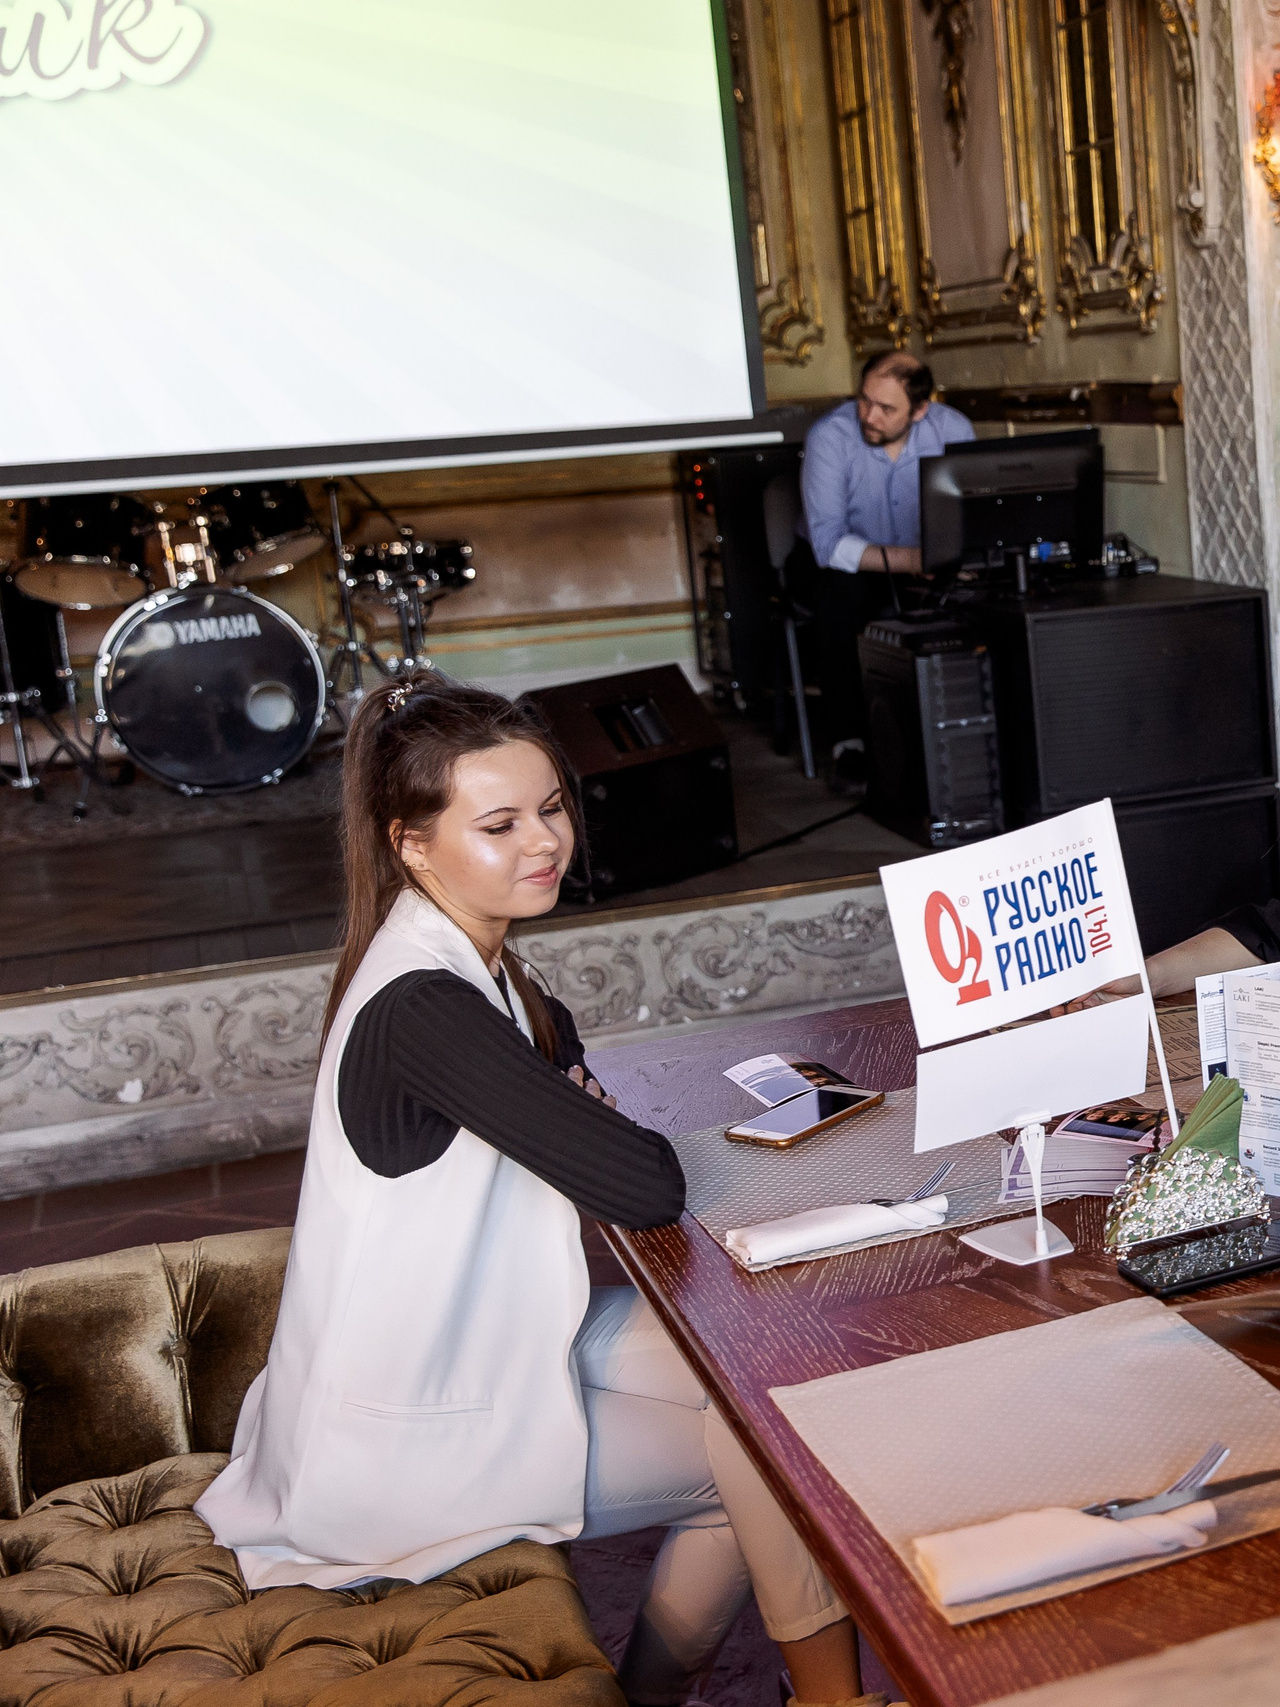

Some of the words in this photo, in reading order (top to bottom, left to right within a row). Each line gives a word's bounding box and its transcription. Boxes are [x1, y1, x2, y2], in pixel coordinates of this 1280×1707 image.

[173, 612, 262, 645] YAMAHA
[979, 869, 1000, 882] ВСЕ
[1009, 855, 1043, 873] БУДЕТ
[1051, 837, 1093, 858] ХОРОШО
[982, 851, 1103, 936] РУССКОЕ
[995, 917, 1087, 992] РАДИО
[1233, 993, 1250, 1002] LAKI
